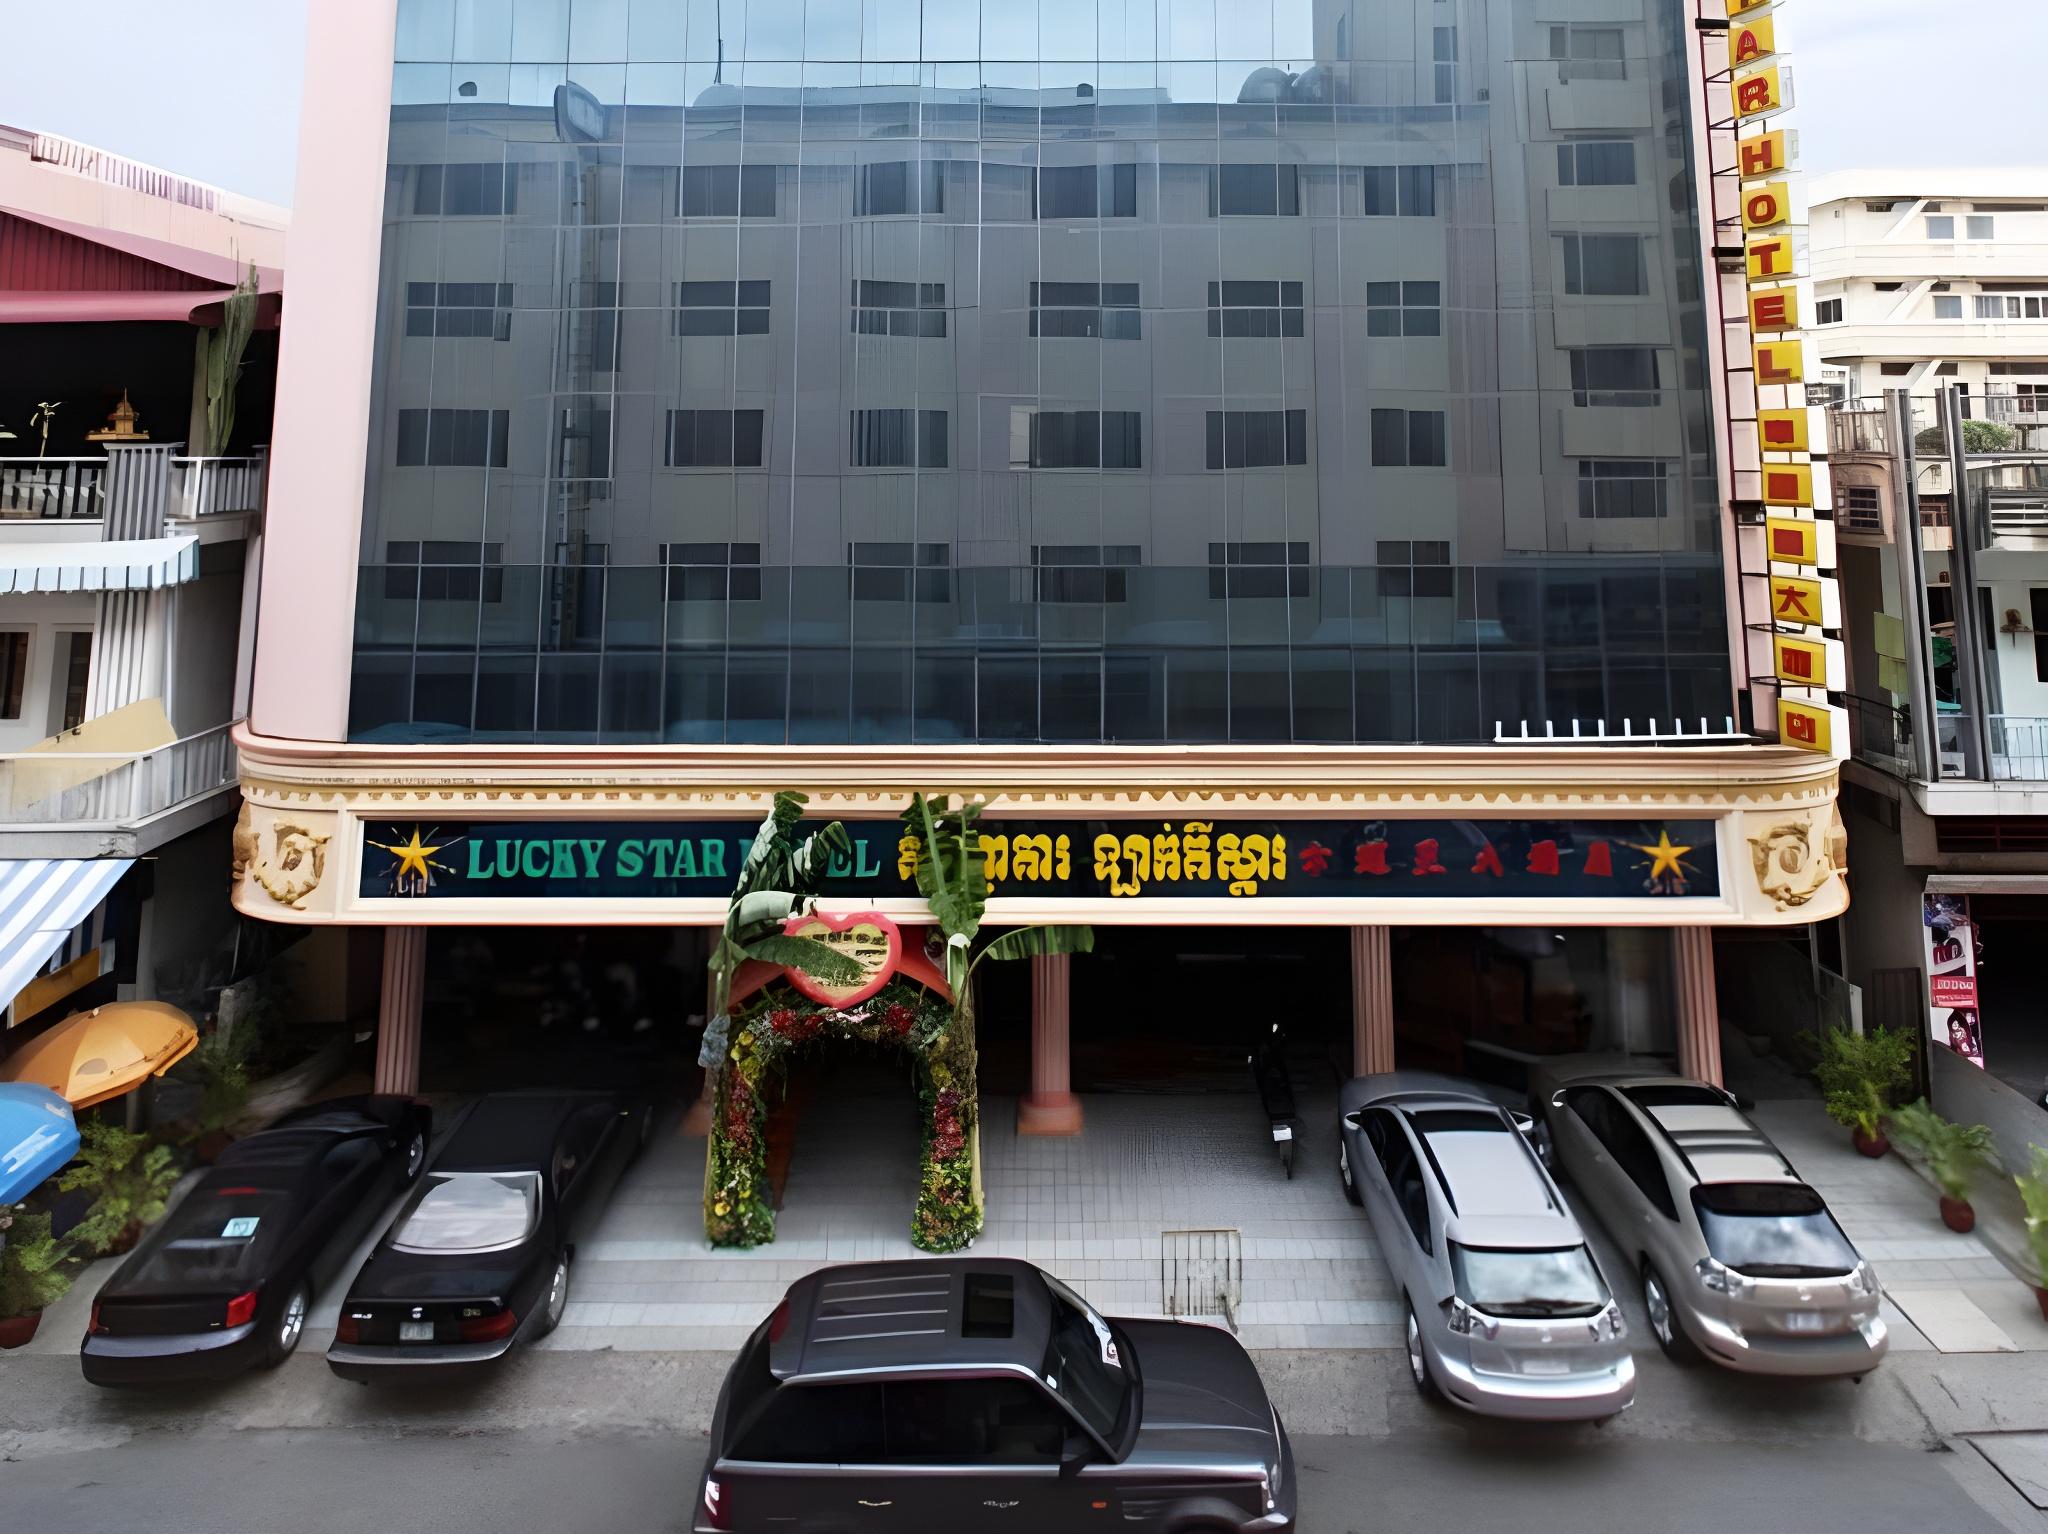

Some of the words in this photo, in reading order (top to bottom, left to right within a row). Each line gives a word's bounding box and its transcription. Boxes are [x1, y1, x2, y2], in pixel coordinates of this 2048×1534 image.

[1736, 0, 1770, 112] AR
[1742, 139, 1792, 379] HOTEL
[467, 839, 606, 879] LUCKY
[616, 839, 727, 878] STAR
